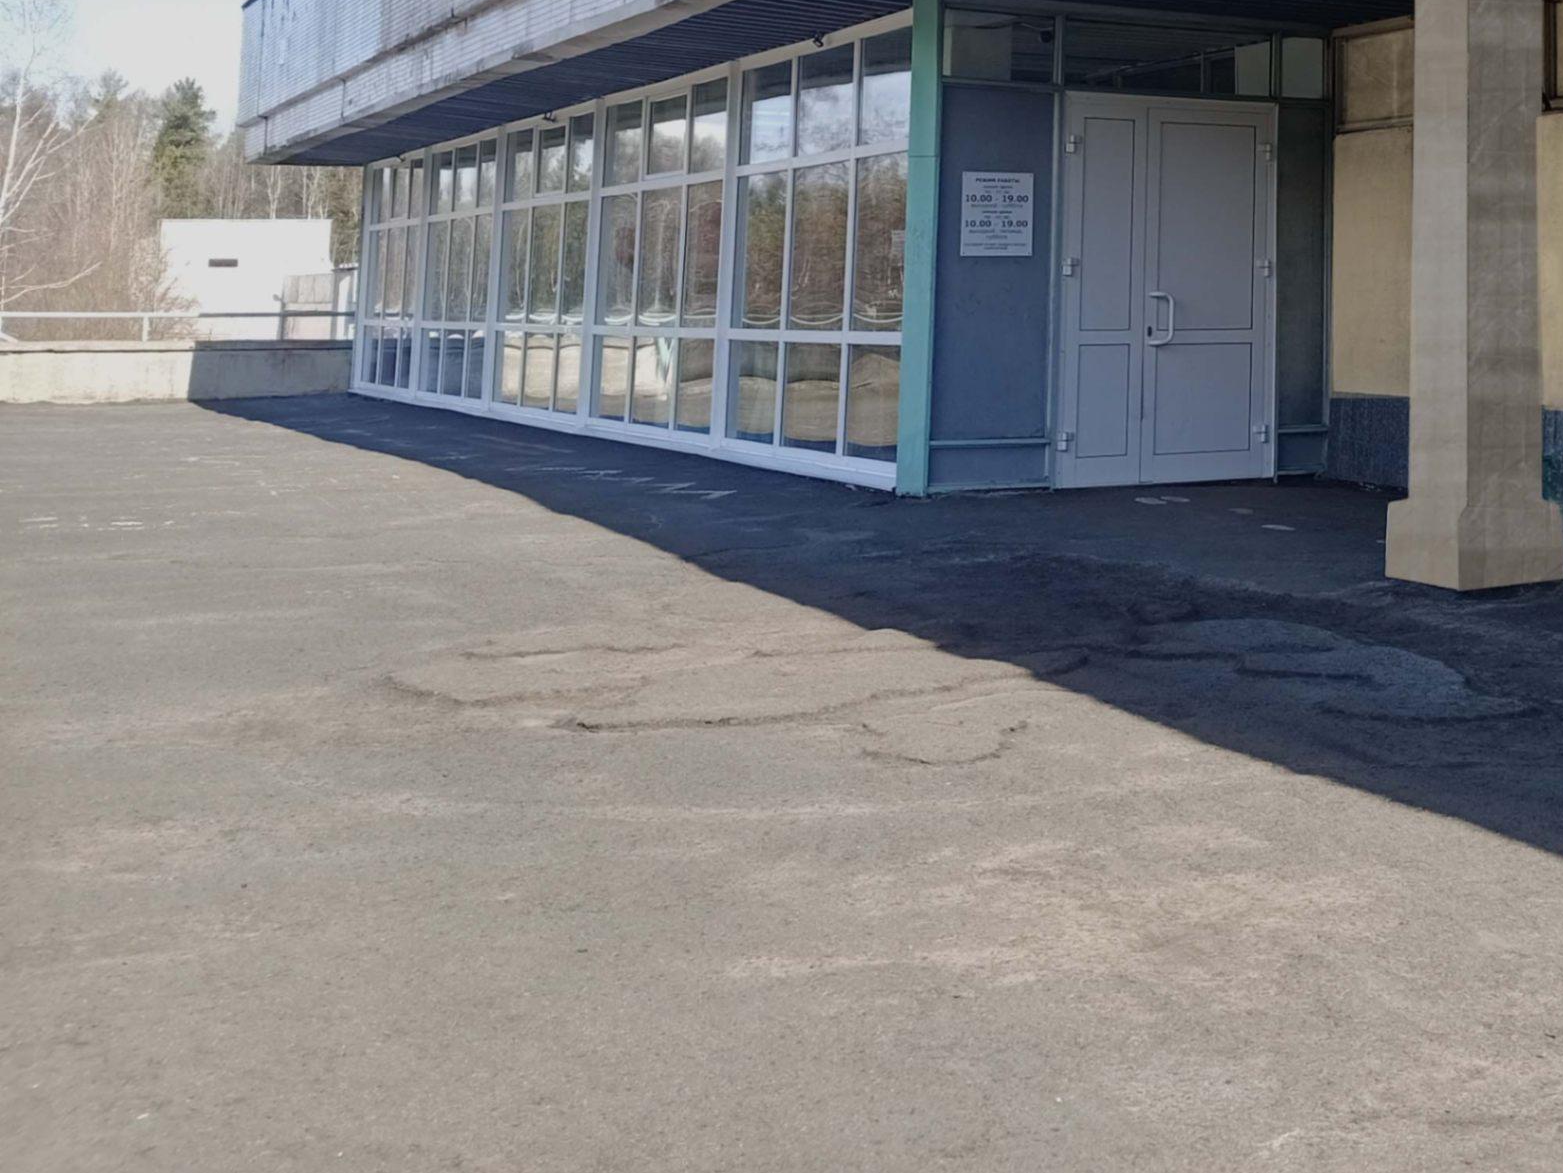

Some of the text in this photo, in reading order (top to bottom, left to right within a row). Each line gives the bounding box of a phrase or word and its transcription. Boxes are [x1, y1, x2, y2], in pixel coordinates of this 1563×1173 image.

[965, 194, 1029, 203] 10.00 19.00
[964, 219, 1028, 228] 10.00 19.00
